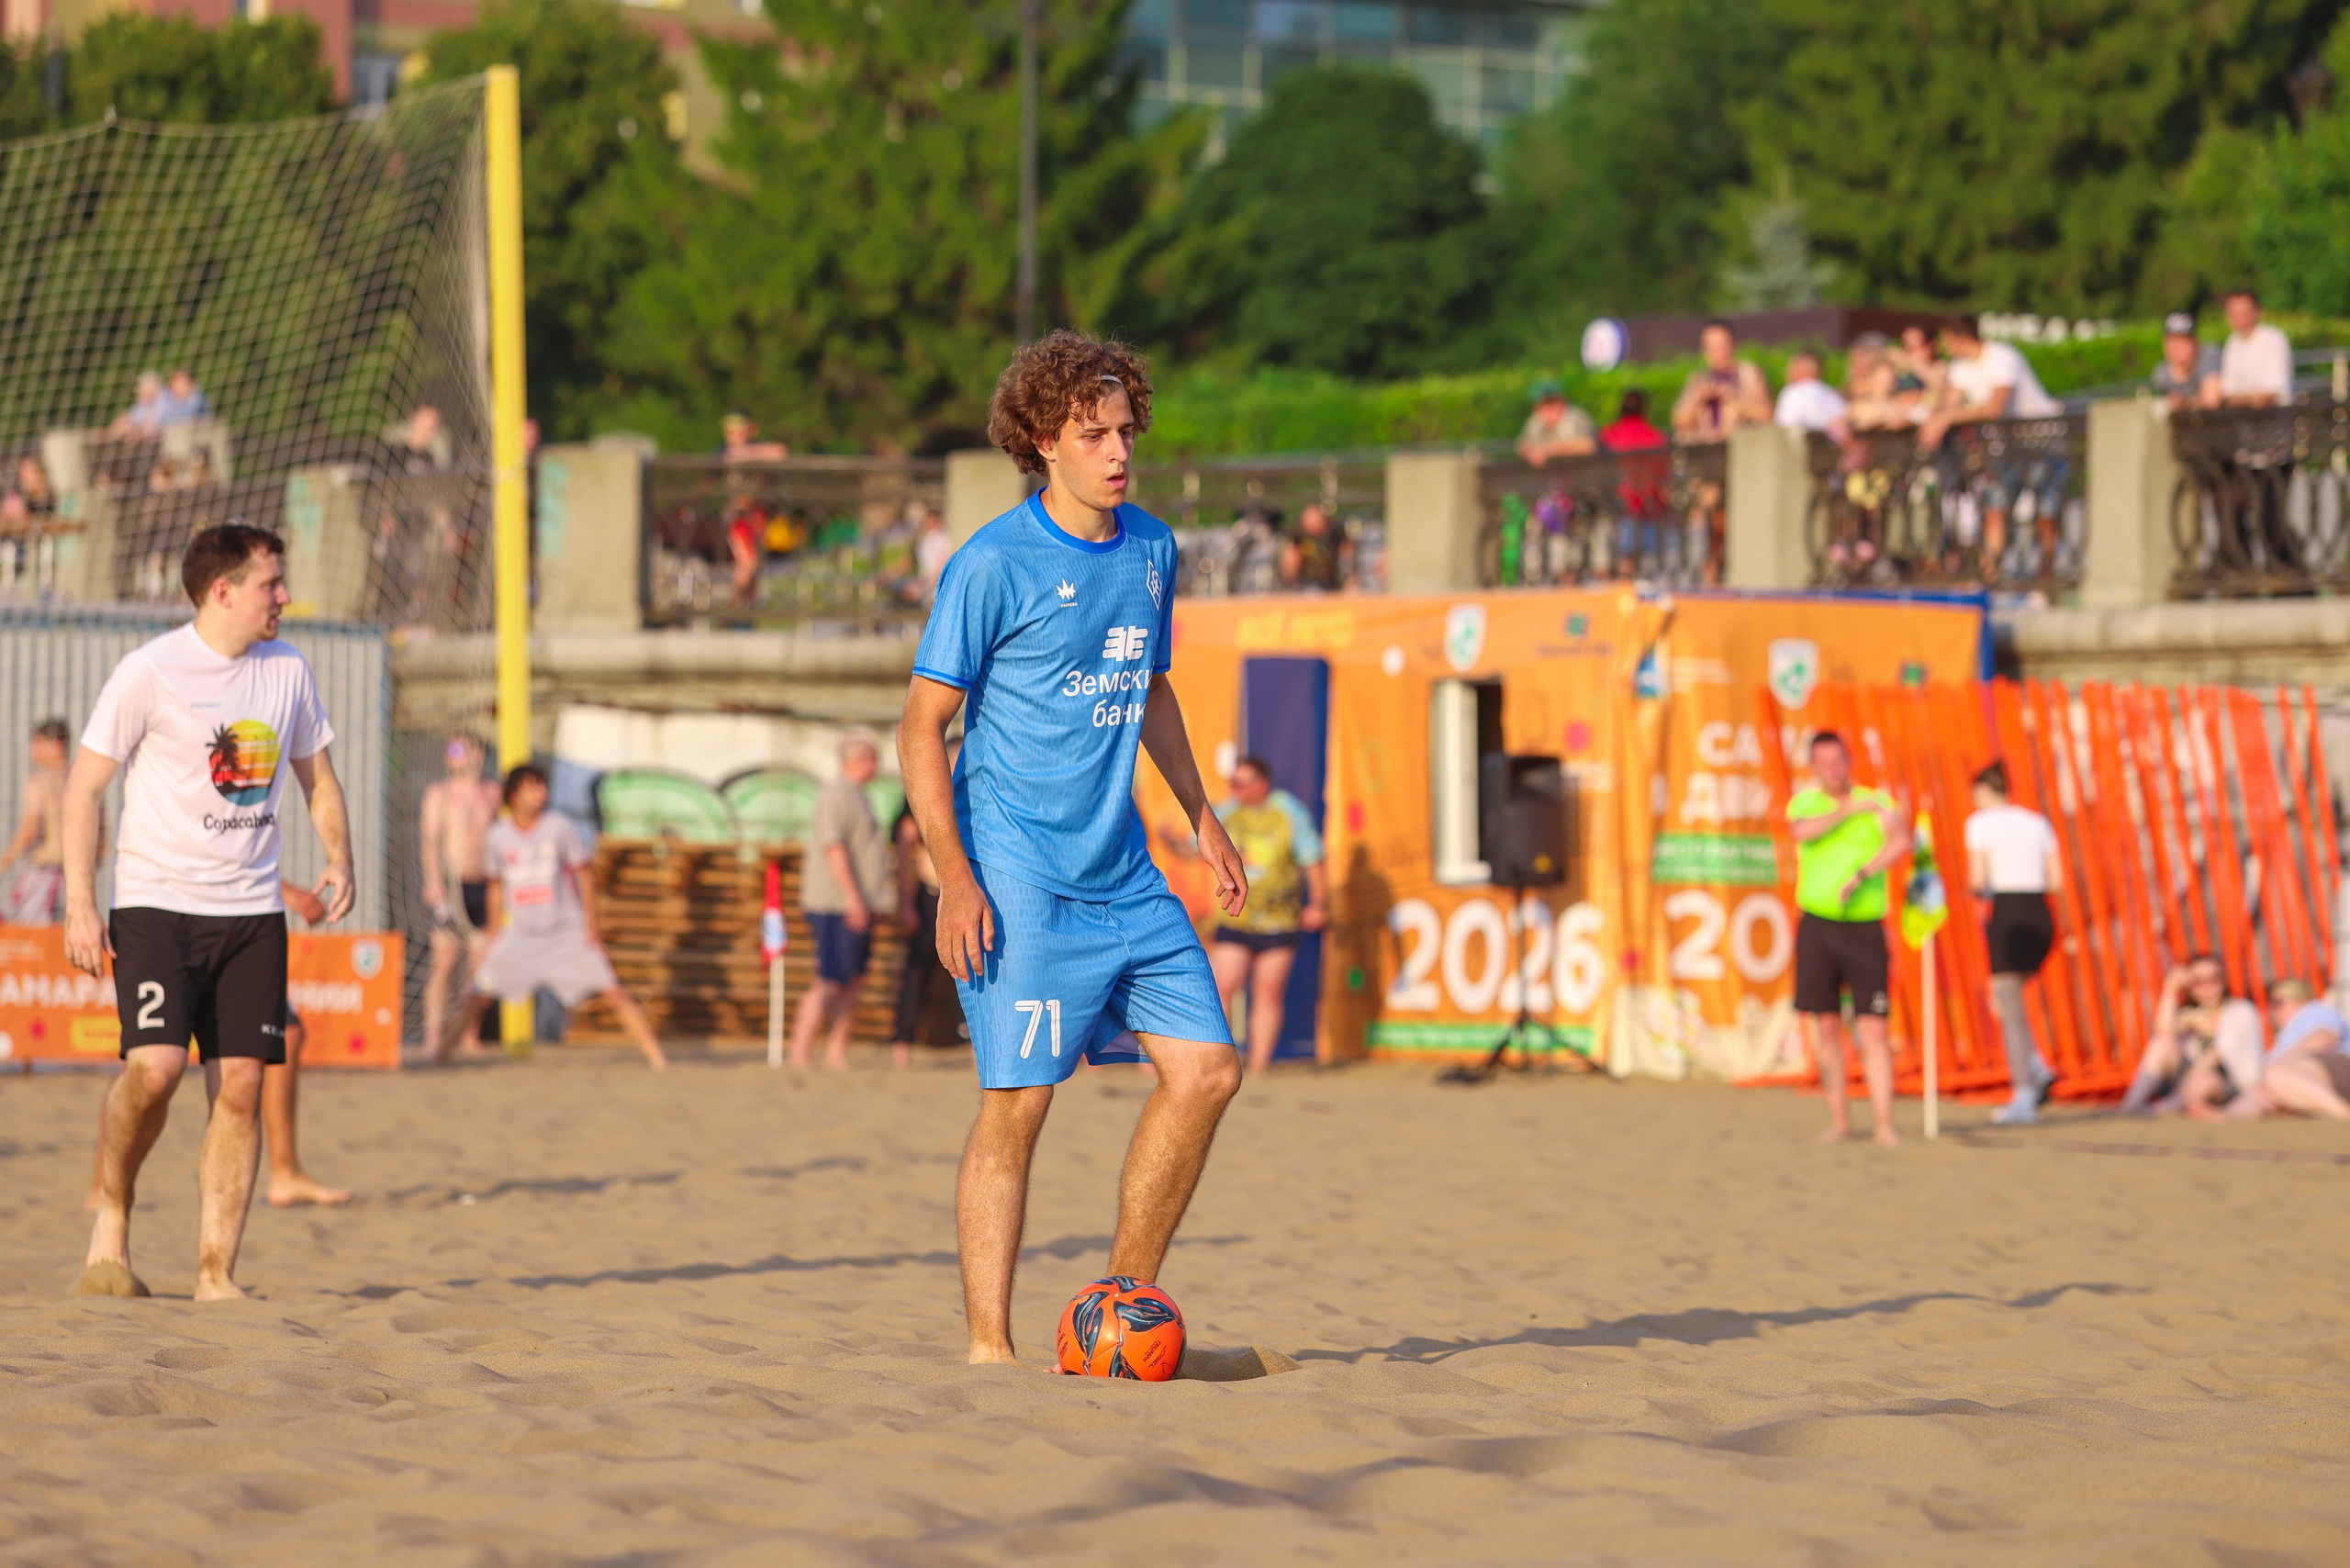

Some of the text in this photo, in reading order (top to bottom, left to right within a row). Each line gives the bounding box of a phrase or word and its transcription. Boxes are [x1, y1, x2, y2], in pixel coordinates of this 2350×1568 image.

[1062, 668, 1153, 697] Земски
[1092, 699, 1147, 728] банк
[1386, 898, 1606, 1014] 2026
[1664, 890, 1794, 983] 20
[138, 980, 165, 1030] 2
[1014, 999, 1061, 1059] 71
[1142, 1339, 1161, 1362] TRIUMPH
